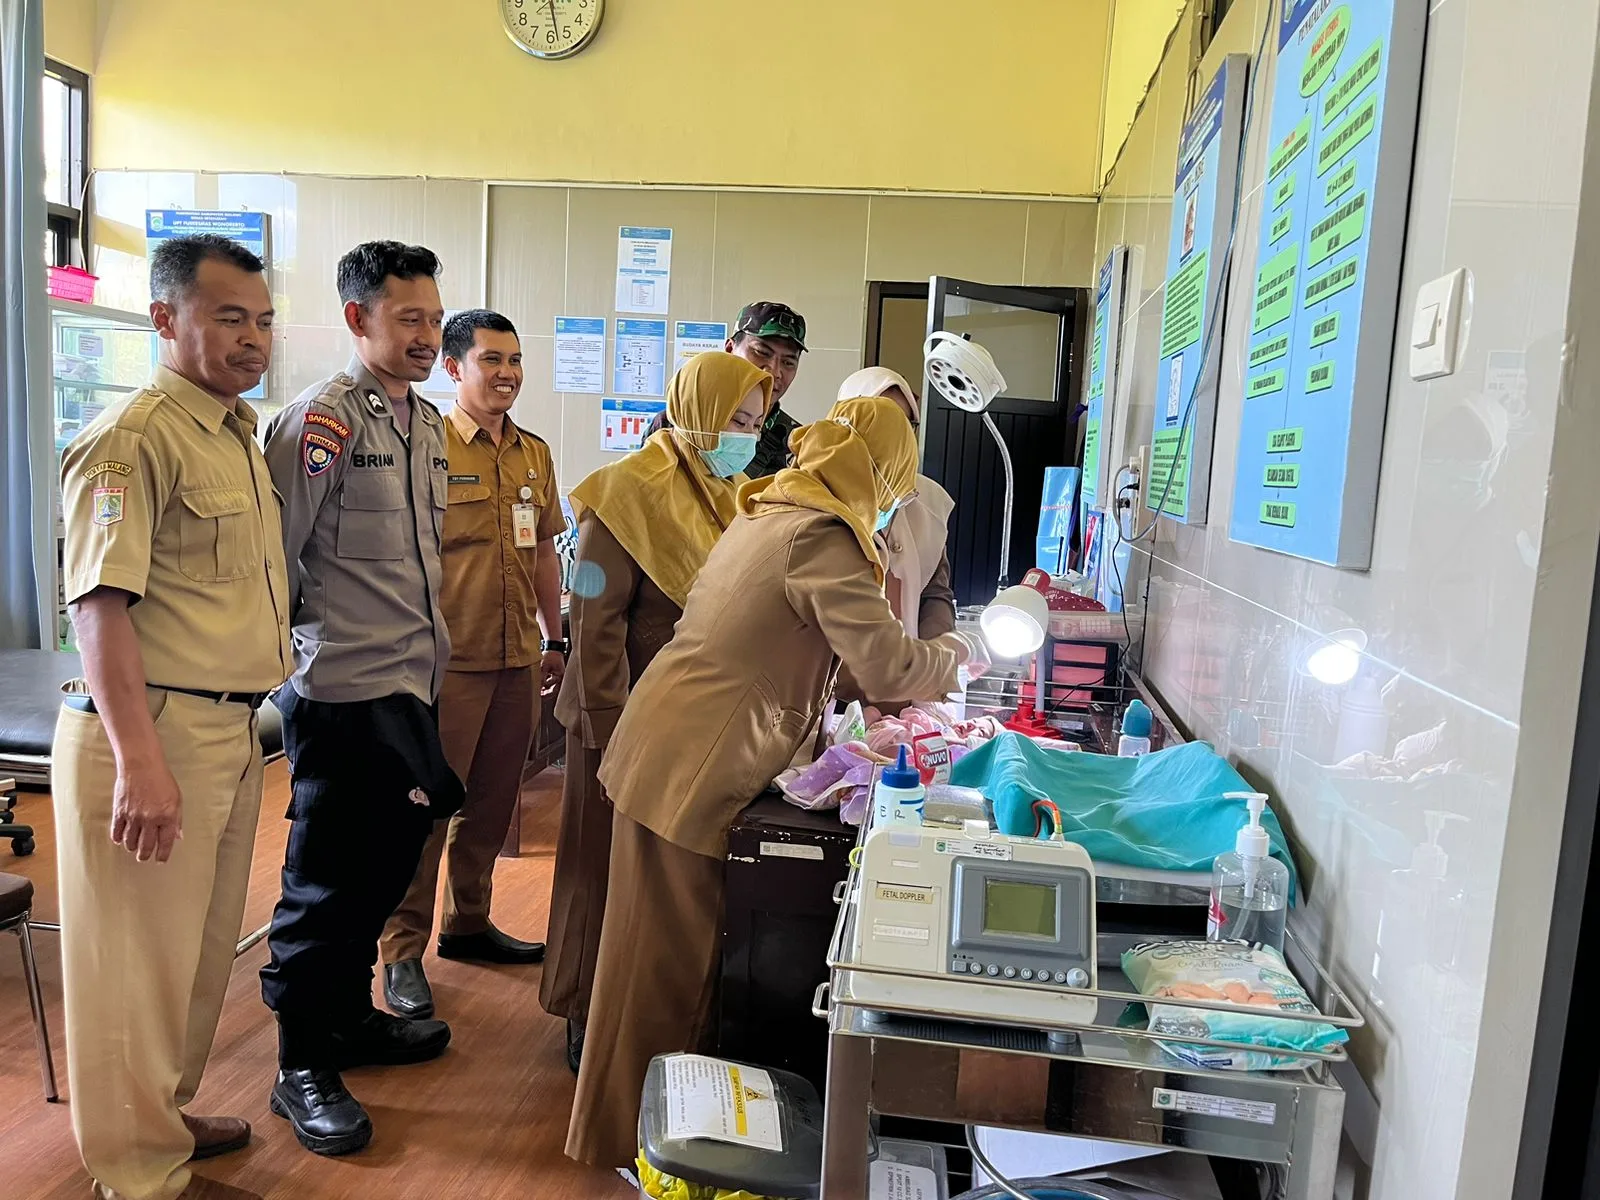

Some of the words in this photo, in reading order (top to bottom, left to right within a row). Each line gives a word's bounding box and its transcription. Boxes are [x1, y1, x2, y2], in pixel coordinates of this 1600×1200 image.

[519, 12, 527, 26] 8
[574, 13, 583, 26] 4
[530, 26, 539, 38] 7
[546, 30, 555, 43] 6
[562, 26, 571, 38] 5
[308, 414, 349, 437] BAHARKAM
[882, 890, 898, 899] FETAL
[899, 891, 925, 901] DOPPLER
